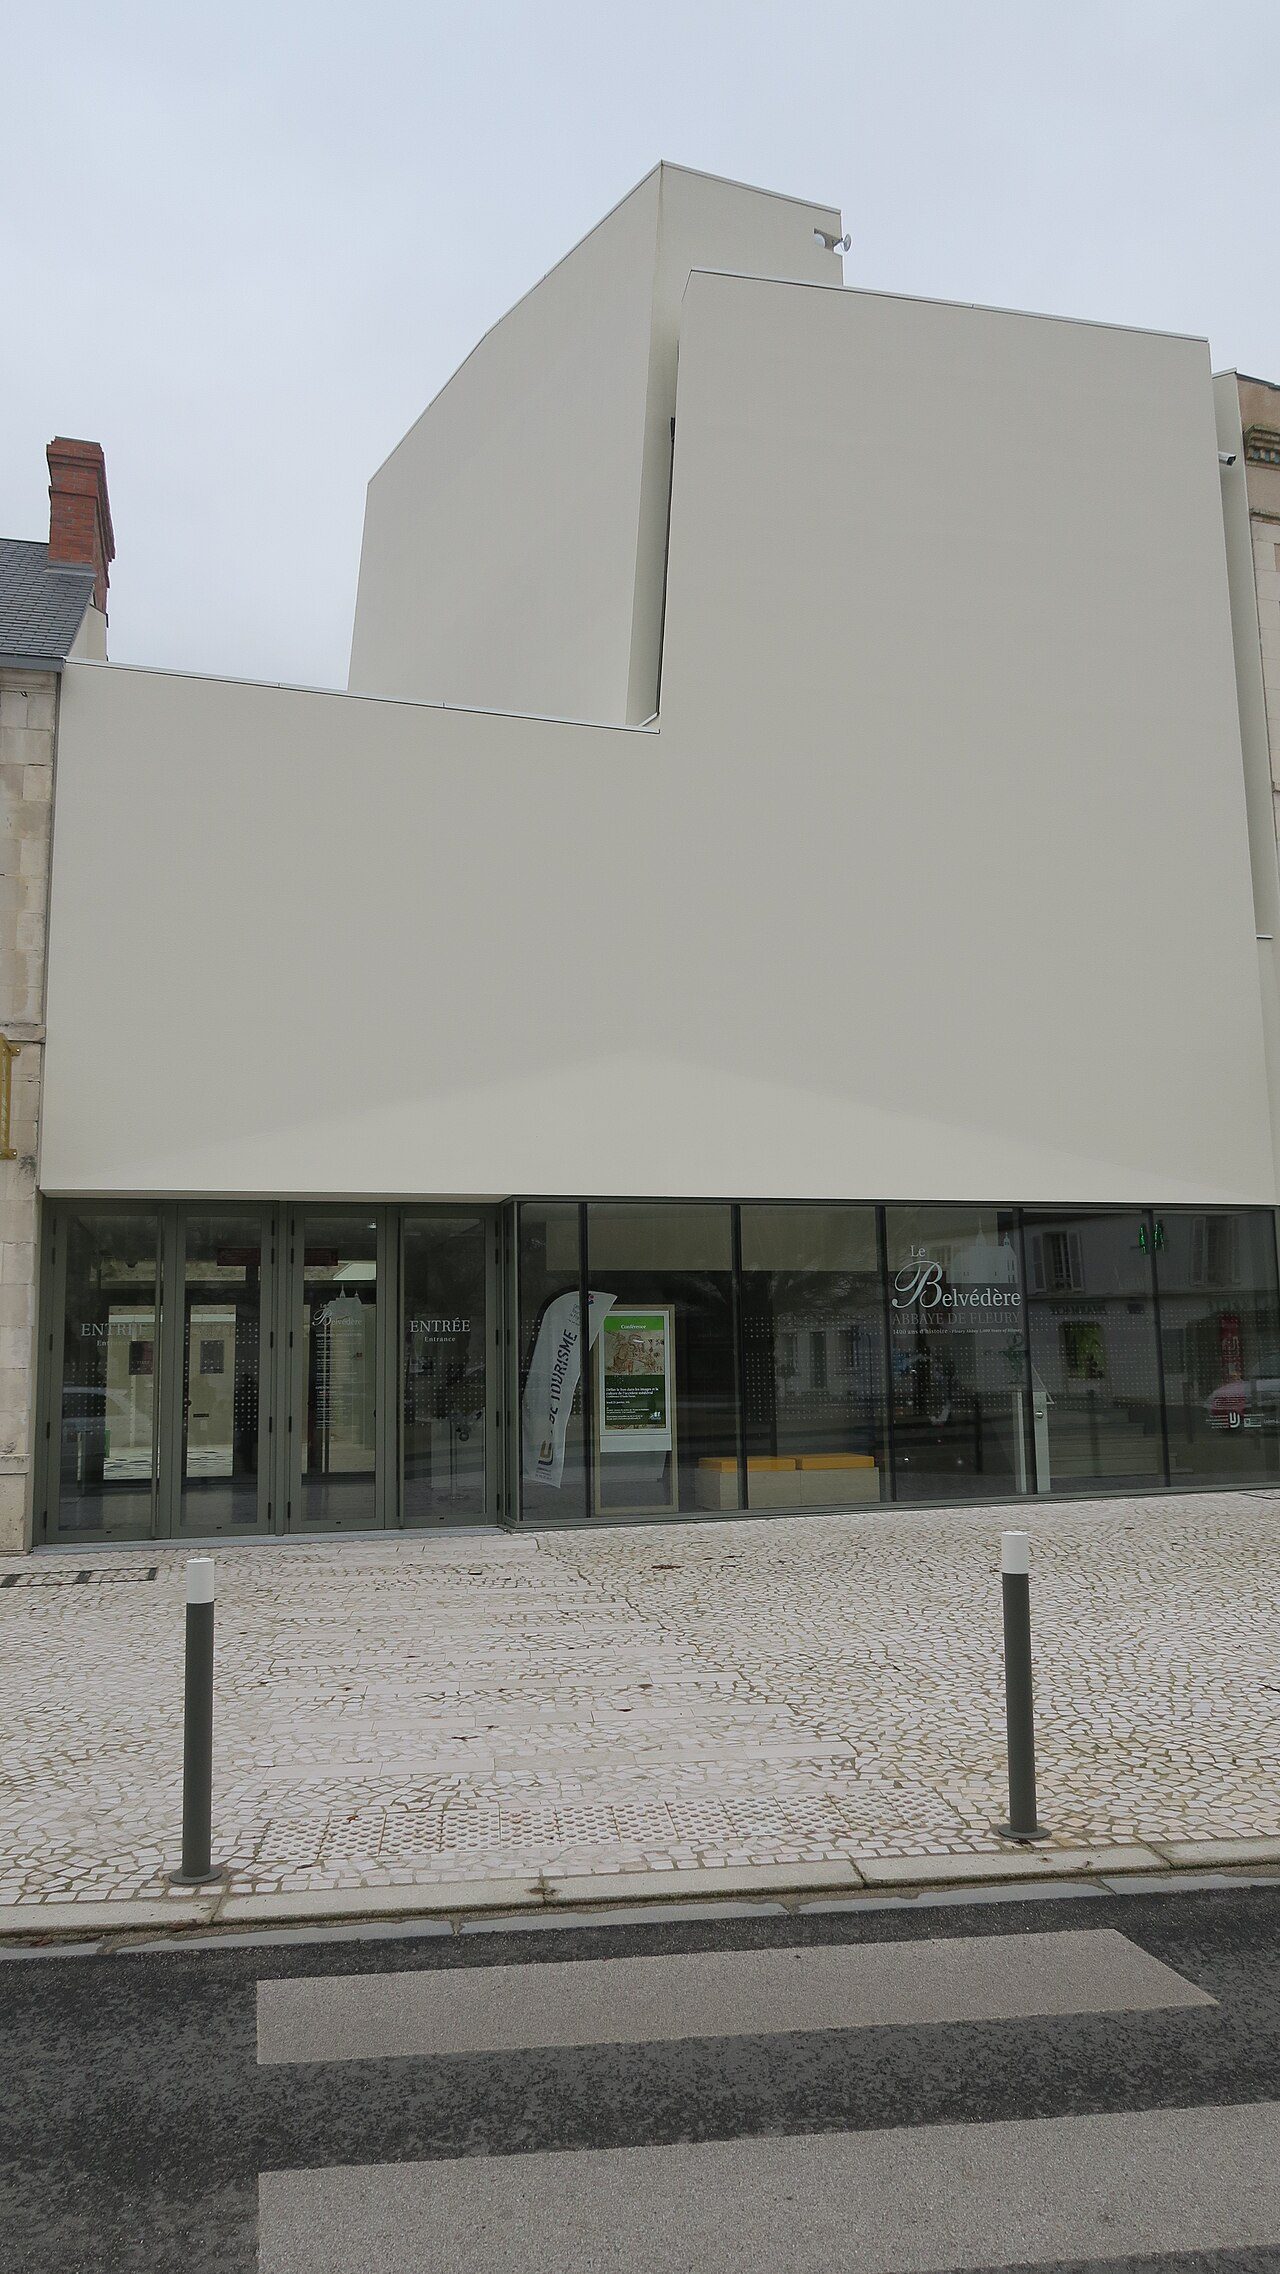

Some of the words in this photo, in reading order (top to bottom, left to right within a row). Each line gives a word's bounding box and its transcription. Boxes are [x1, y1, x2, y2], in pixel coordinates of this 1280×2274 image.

[911, 1245, 926, 1257] Le
[891, 1260, 1021, 1309] Belvédère
[410, 1317, 471, 1333] ENTRÉE
[893, 1312, 943, 1325] ABBAYE
[948, 1312, 968, 1325] DE
[970, 1311, 1020, 1324] FLEURY
[550, 1328, 578, 1401] TOURISME
